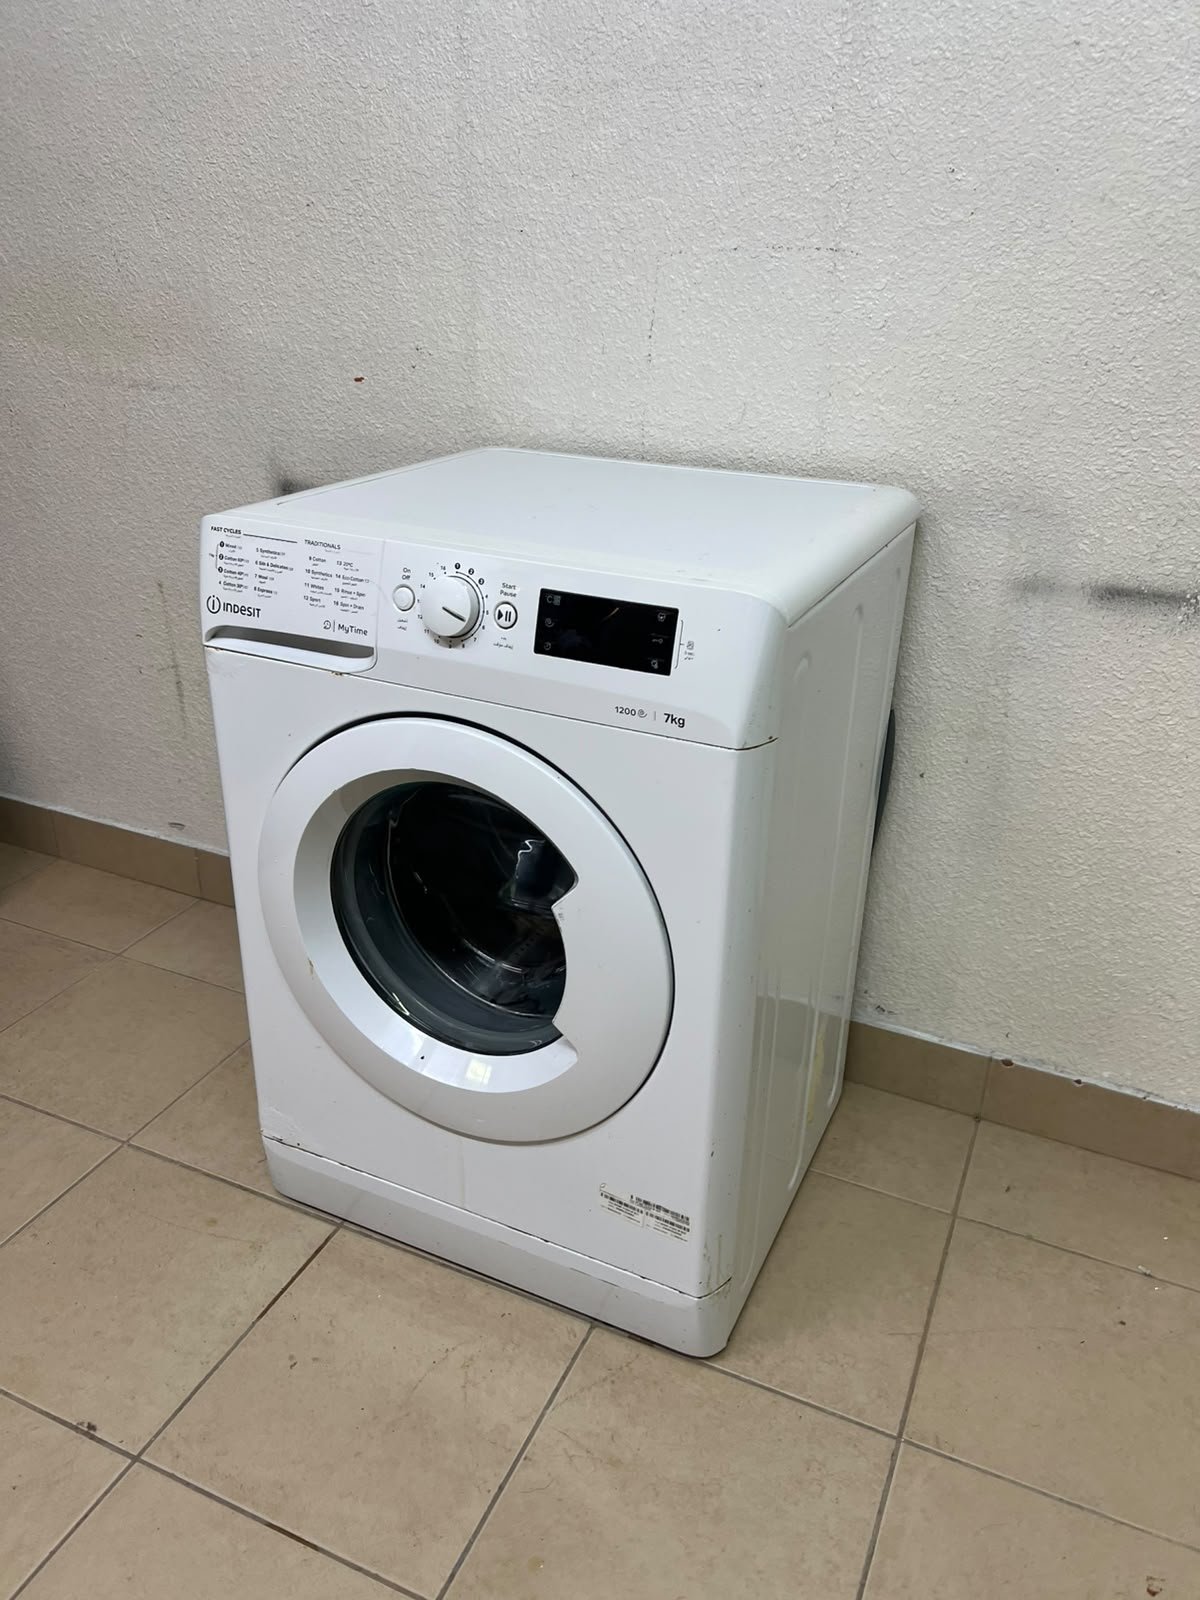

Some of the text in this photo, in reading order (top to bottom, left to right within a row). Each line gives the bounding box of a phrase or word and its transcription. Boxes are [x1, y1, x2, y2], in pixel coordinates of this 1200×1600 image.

[304, 539, 341, 549] TRADITIONALS
[312, 570, 332, 578] Synthetics
[223, 602, 261, 618] INDESIT
[338, 623, 368, 636] MyTime
[615, 706, 685, 728] 1200 7kg
